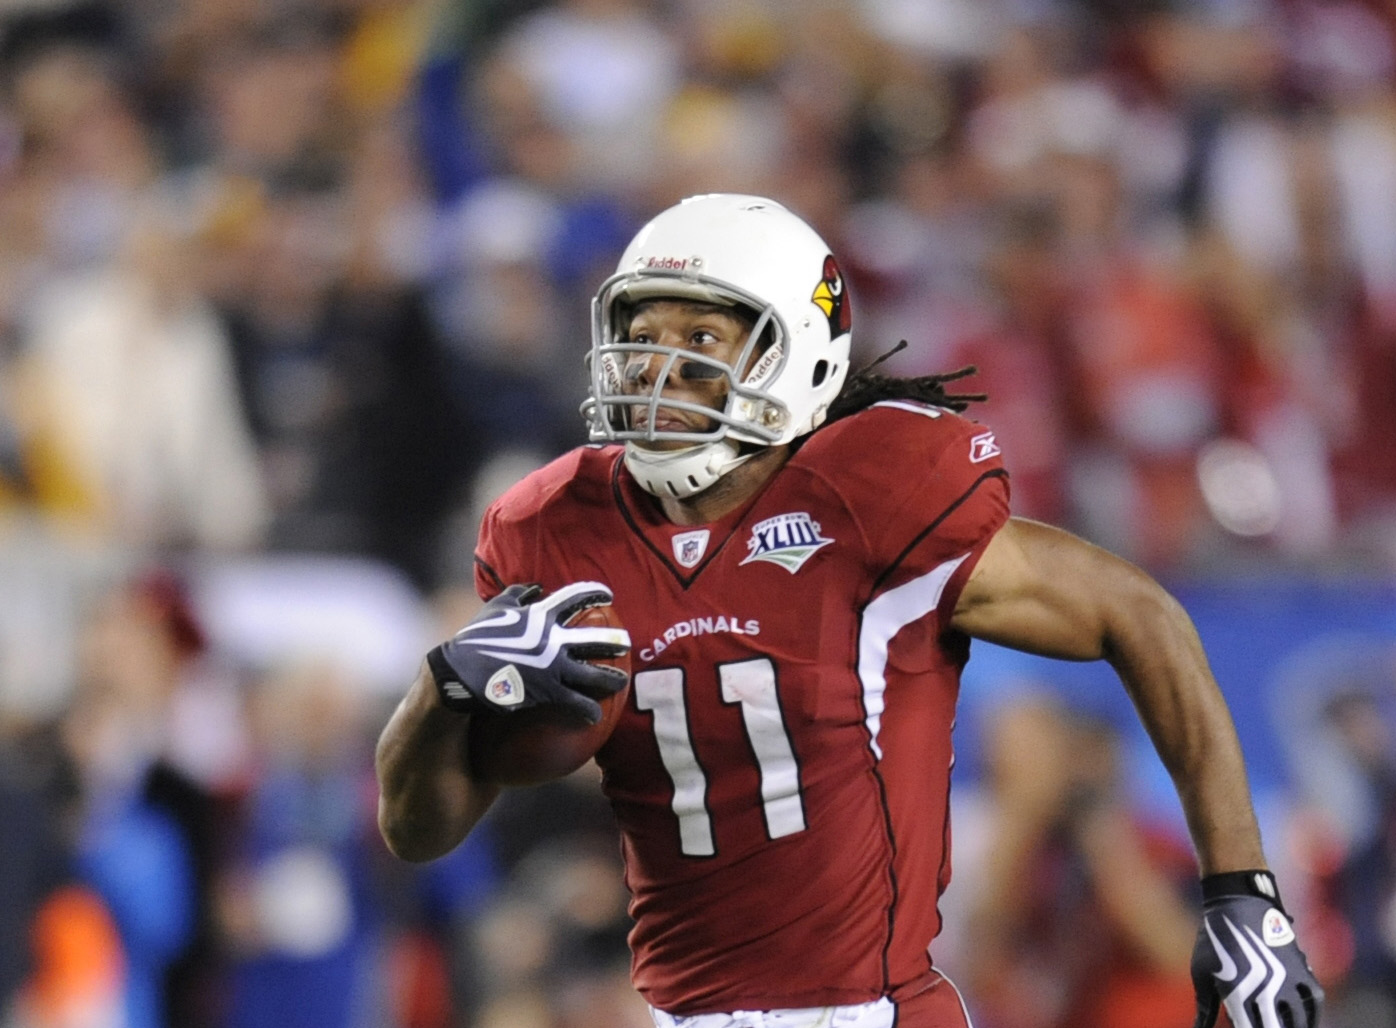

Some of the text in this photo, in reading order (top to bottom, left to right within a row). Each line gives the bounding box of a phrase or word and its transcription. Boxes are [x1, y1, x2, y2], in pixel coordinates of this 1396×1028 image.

[648, 256, 688, 269] Riddel
[752, 521, 820, 558] XLIII
[639, 615, 761, 661] CARDINALS
[634, 656, 809, 856] 11
